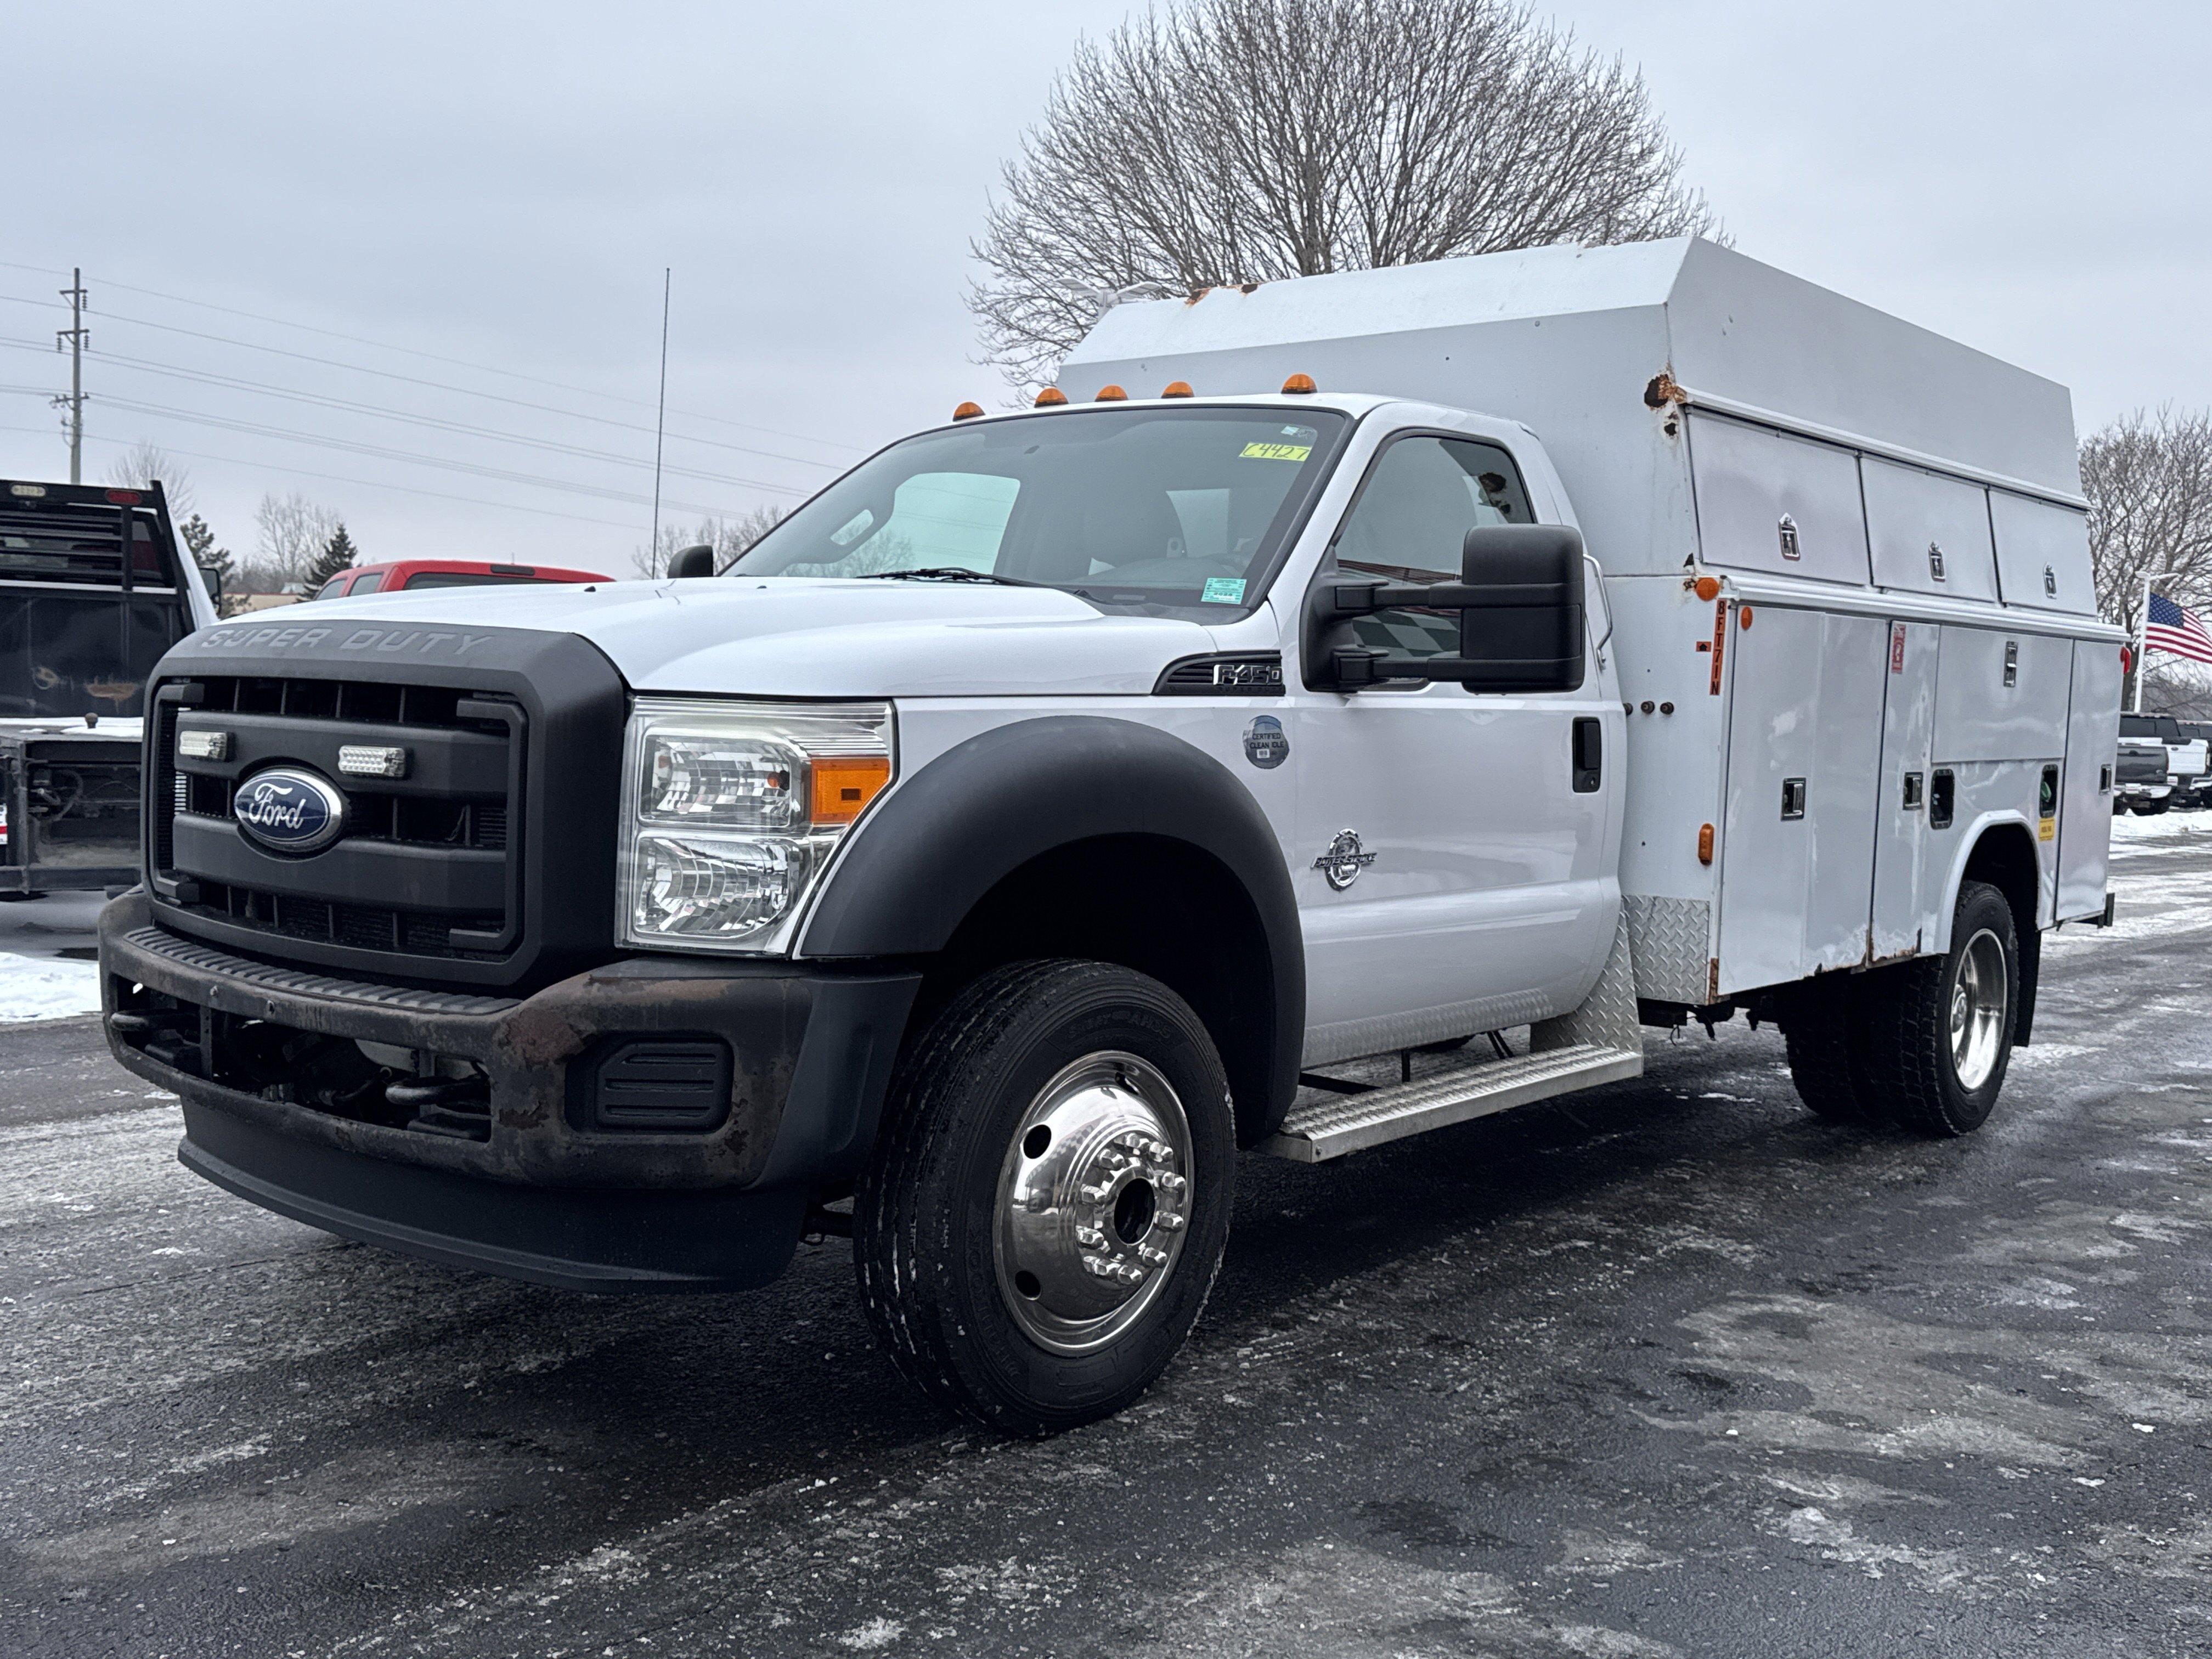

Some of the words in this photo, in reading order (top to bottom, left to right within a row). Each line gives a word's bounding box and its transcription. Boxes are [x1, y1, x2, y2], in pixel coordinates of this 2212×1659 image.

[1243, 443, 1310, 460] C4427
[201, 628, 332, 648] SUPER
[338, 630, 494, 655] DUTY
[1213, 664, 1283, 685] F-450
[249, 783, 306, 830] Ford
